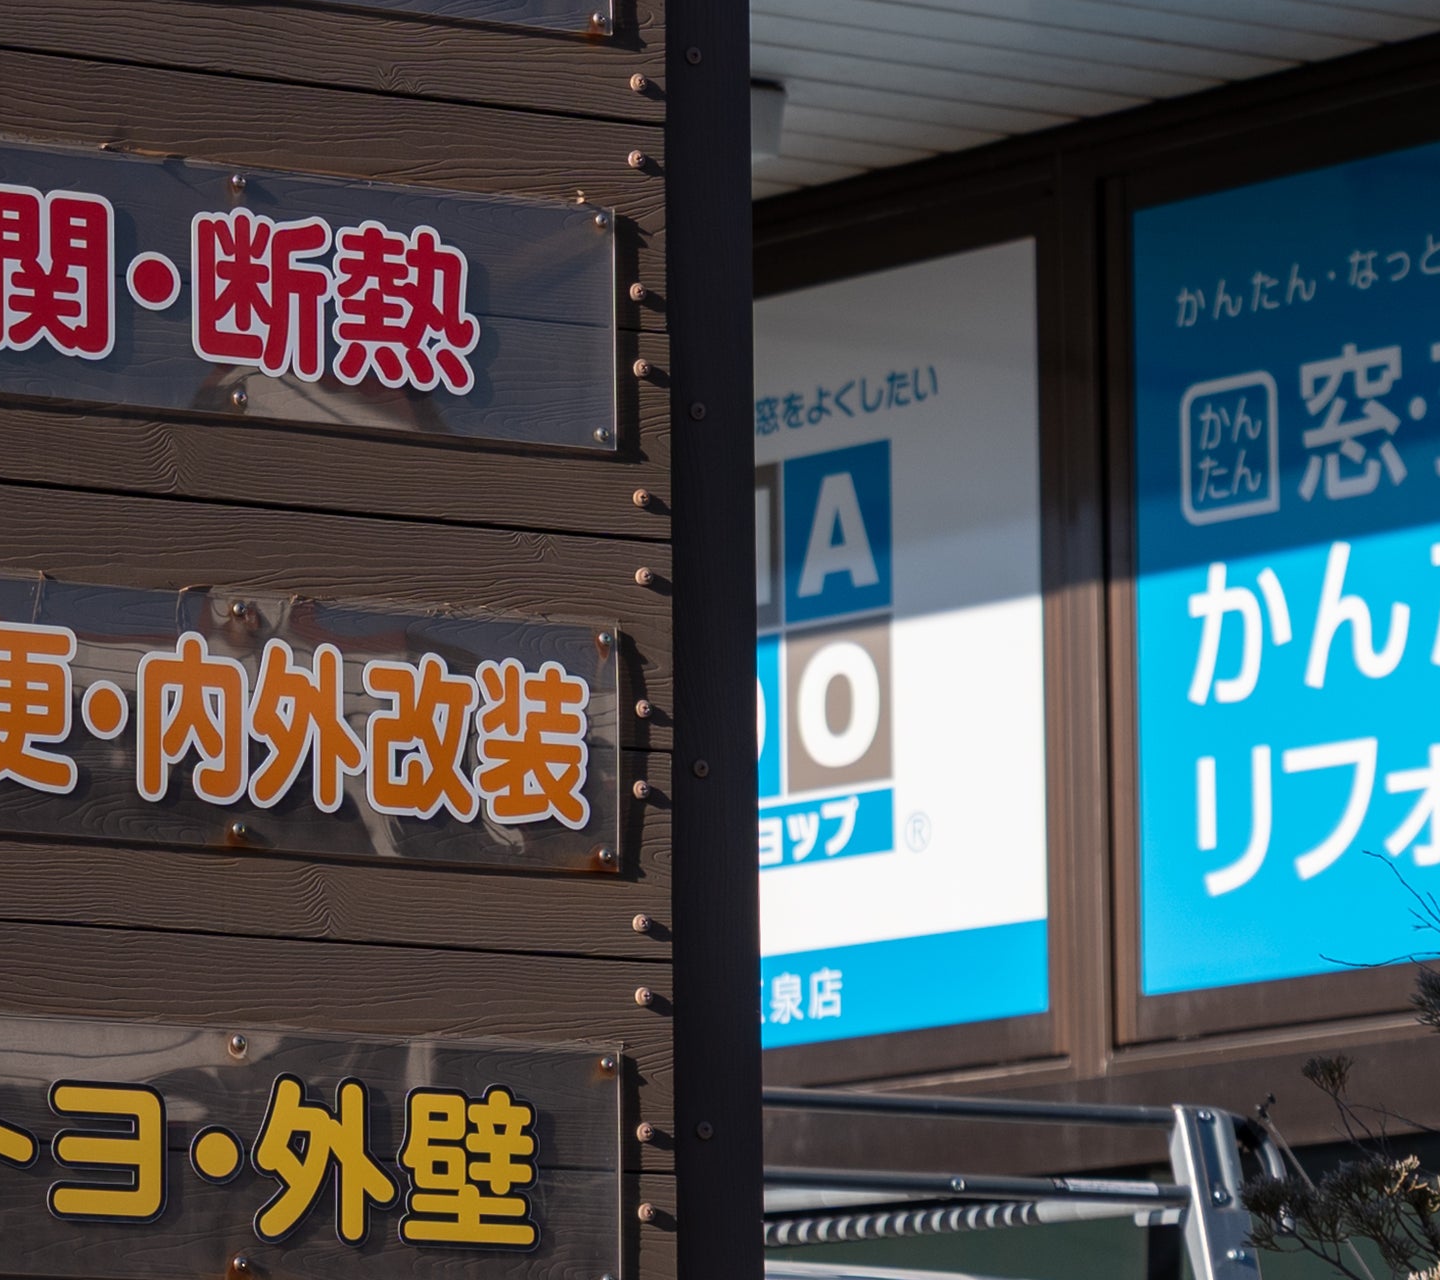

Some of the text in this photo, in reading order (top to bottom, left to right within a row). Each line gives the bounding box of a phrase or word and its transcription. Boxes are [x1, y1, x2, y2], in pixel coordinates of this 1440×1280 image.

[755, 472, 880, 606] A
[757, 641, 880, 767] O
[761, 967, 843, 1025] 泉店
